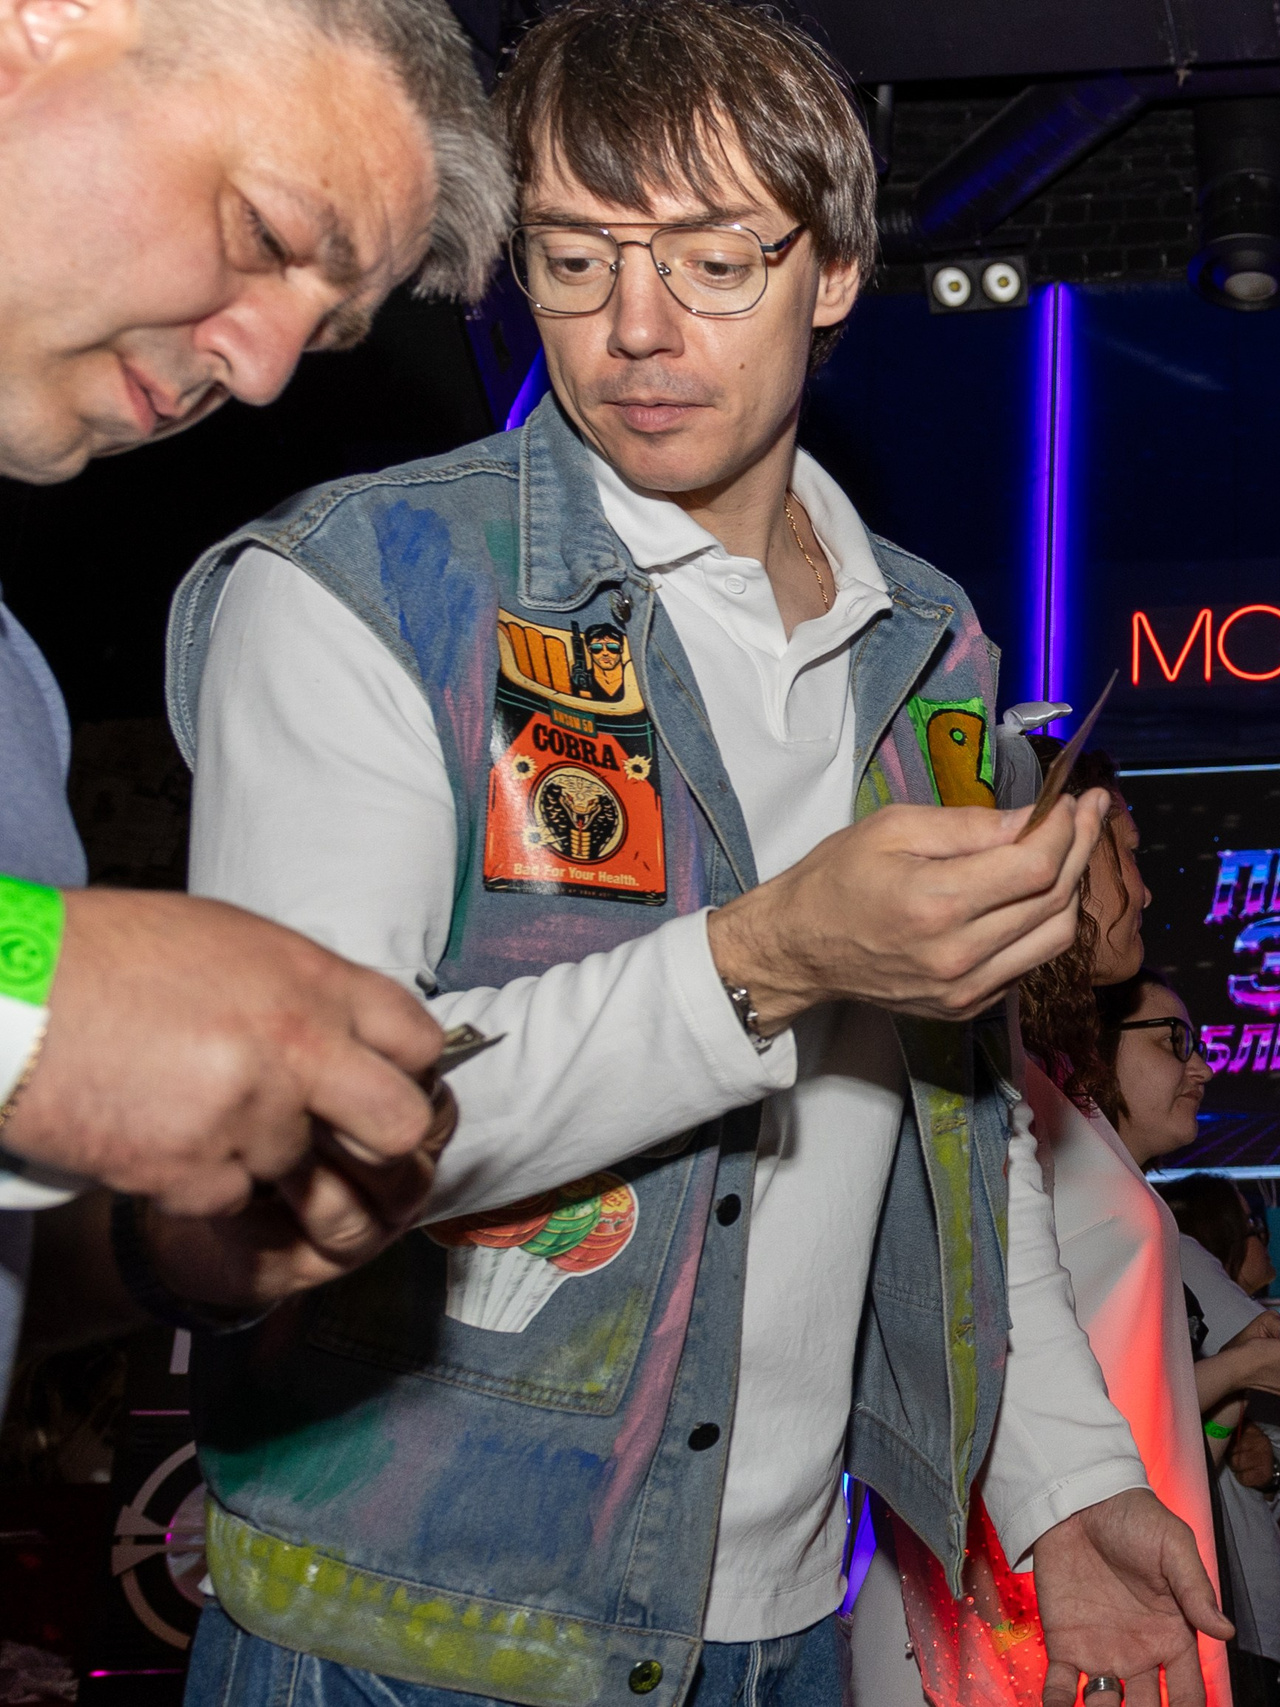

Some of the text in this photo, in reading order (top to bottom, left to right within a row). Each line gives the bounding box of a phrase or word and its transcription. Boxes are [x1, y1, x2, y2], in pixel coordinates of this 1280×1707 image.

[533, 723, 620, 771] COBRA
[513, 862, 640, 887] Bad For Your Health.
